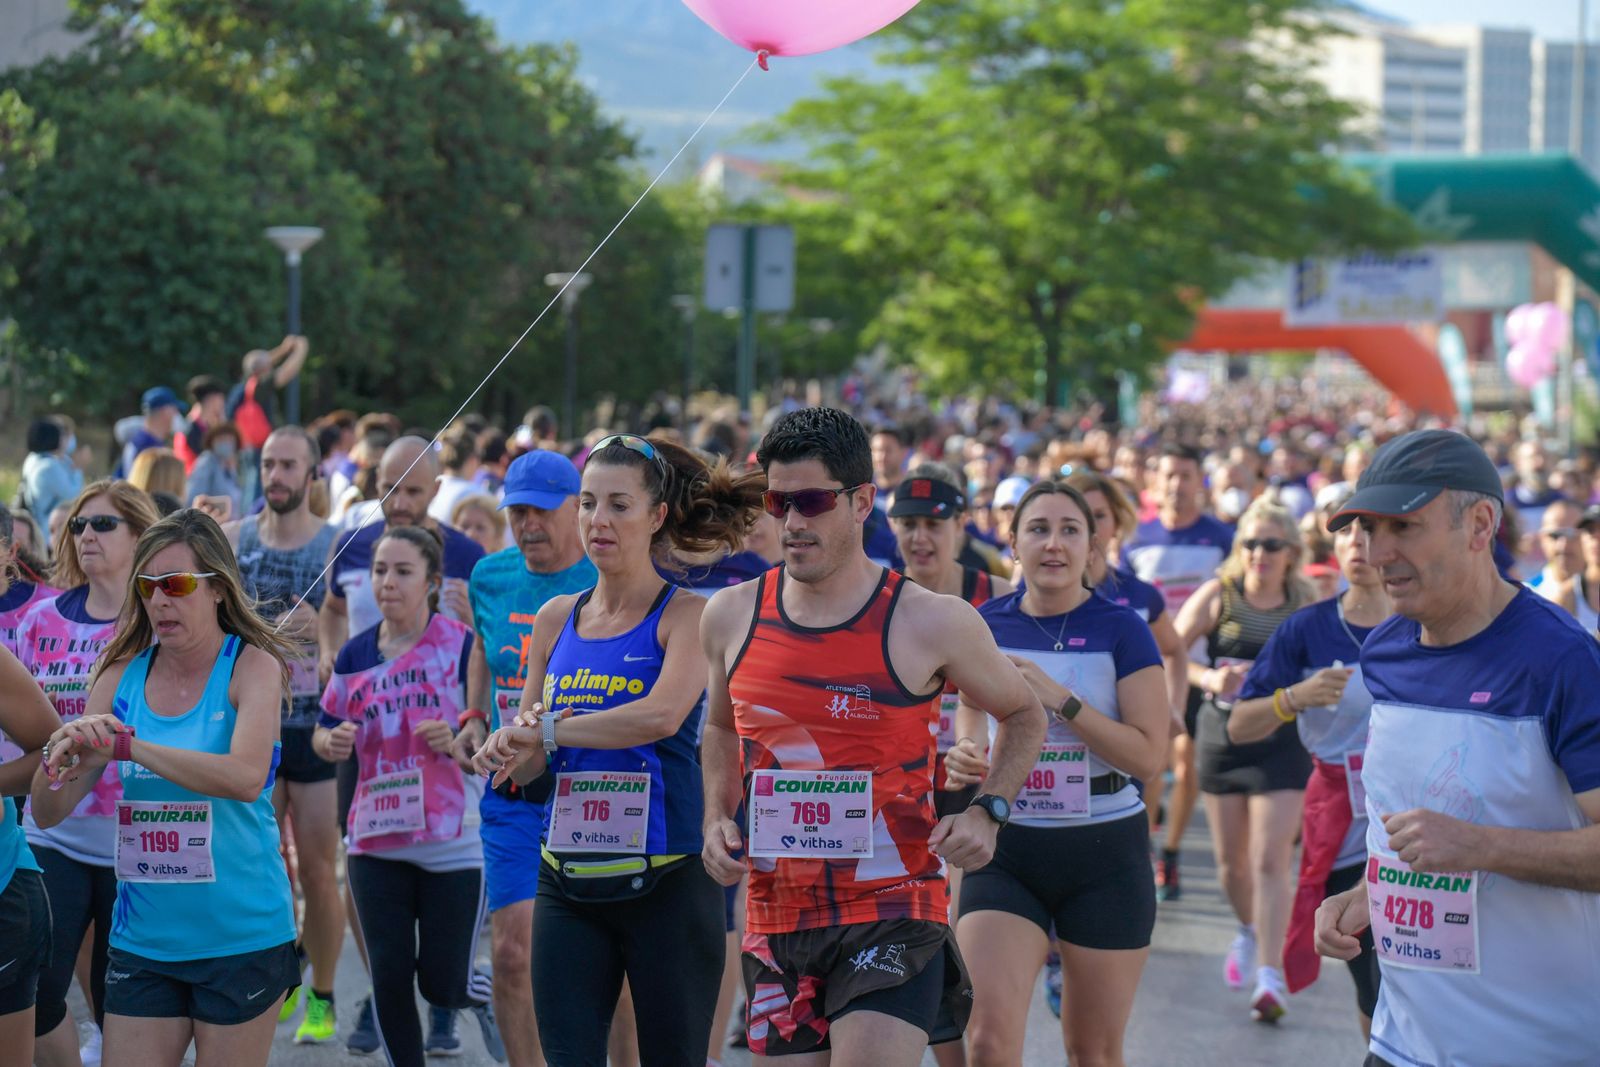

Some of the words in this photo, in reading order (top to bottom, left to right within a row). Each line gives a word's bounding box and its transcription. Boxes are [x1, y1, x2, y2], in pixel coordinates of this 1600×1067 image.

[39, 637, 62, 652] TU
[67, 639, 108, 653] LUC
[46, 662, 67, 676] MI
[44, 682, 88, 693] COVIR
[372, 669, 428, 694] LUCHA
[559, 668, 644, 696] olimpo
[825, 685, 857, 693] ATLETISMO
[54, 697, 86, 716] 056
[384, 693, 440, 714] LUCHA
[555, 693, 604, 706] deportes
[849, 712, 880, 721] ALBOLOTE
[1040, 751, 1085, 762] IRAN
[824, 773, 868, 781] Fundación
[570, 780, 647, 793] COVIRAN
[774, 780, 868, 794] COVIRAN
[374, 794, 400, 812] 1170
[1030, 799, 1065, 810] vithas
[132, 810, 207, 823] COVIRAN
[582, 800, 610, 822] 176
[790, 801, 831, 825] 769
[139, 830, 180, 853] 1199
[584, 832, 621, 844] vithas
[800, 837, 843, 849] vithas
[151, 864, 188, 875] vithas
[1378, 866, 1472, 893] COVIRAN
[1384, 895, 1434, 930] 4278
[1395, 926, 1419, 938] Manuel
[1395, 942, 1442, 960] vithas
[870, 961, 905, 977] ALBOLOTE
